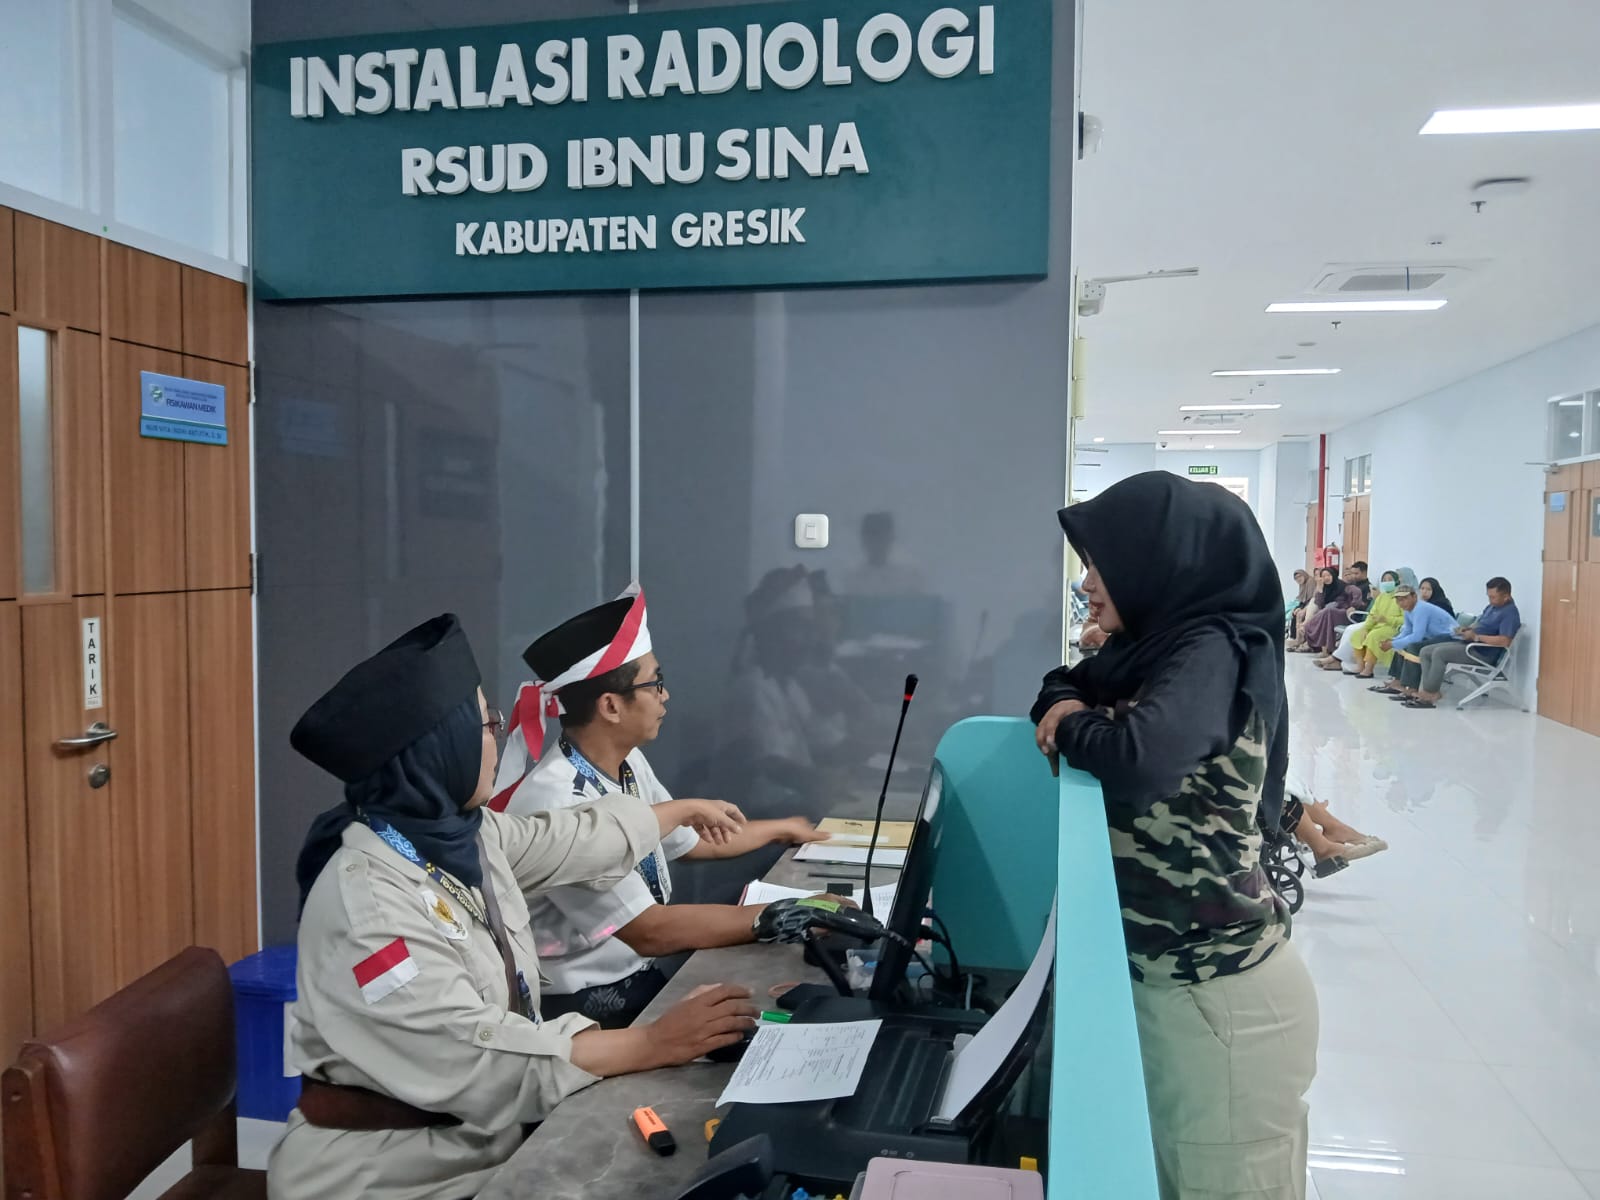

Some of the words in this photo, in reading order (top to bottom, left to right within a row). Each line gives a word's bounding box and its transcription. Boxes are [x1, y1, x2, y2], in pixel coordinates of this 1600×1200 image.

[290, 37, 588, 118] INSTALASI
[607, 5, 995, 99] RADIOLOGI
[401, 143, 548, 195] RSUD
[568, 131, 705, 190] IBNU
[715, 122, 869, 181] SINA
[455, 215, 656, 256] KABUPATEN
[671, 207, 806, 247] GRESIK
[88, 623, 97, 695] TARIK
